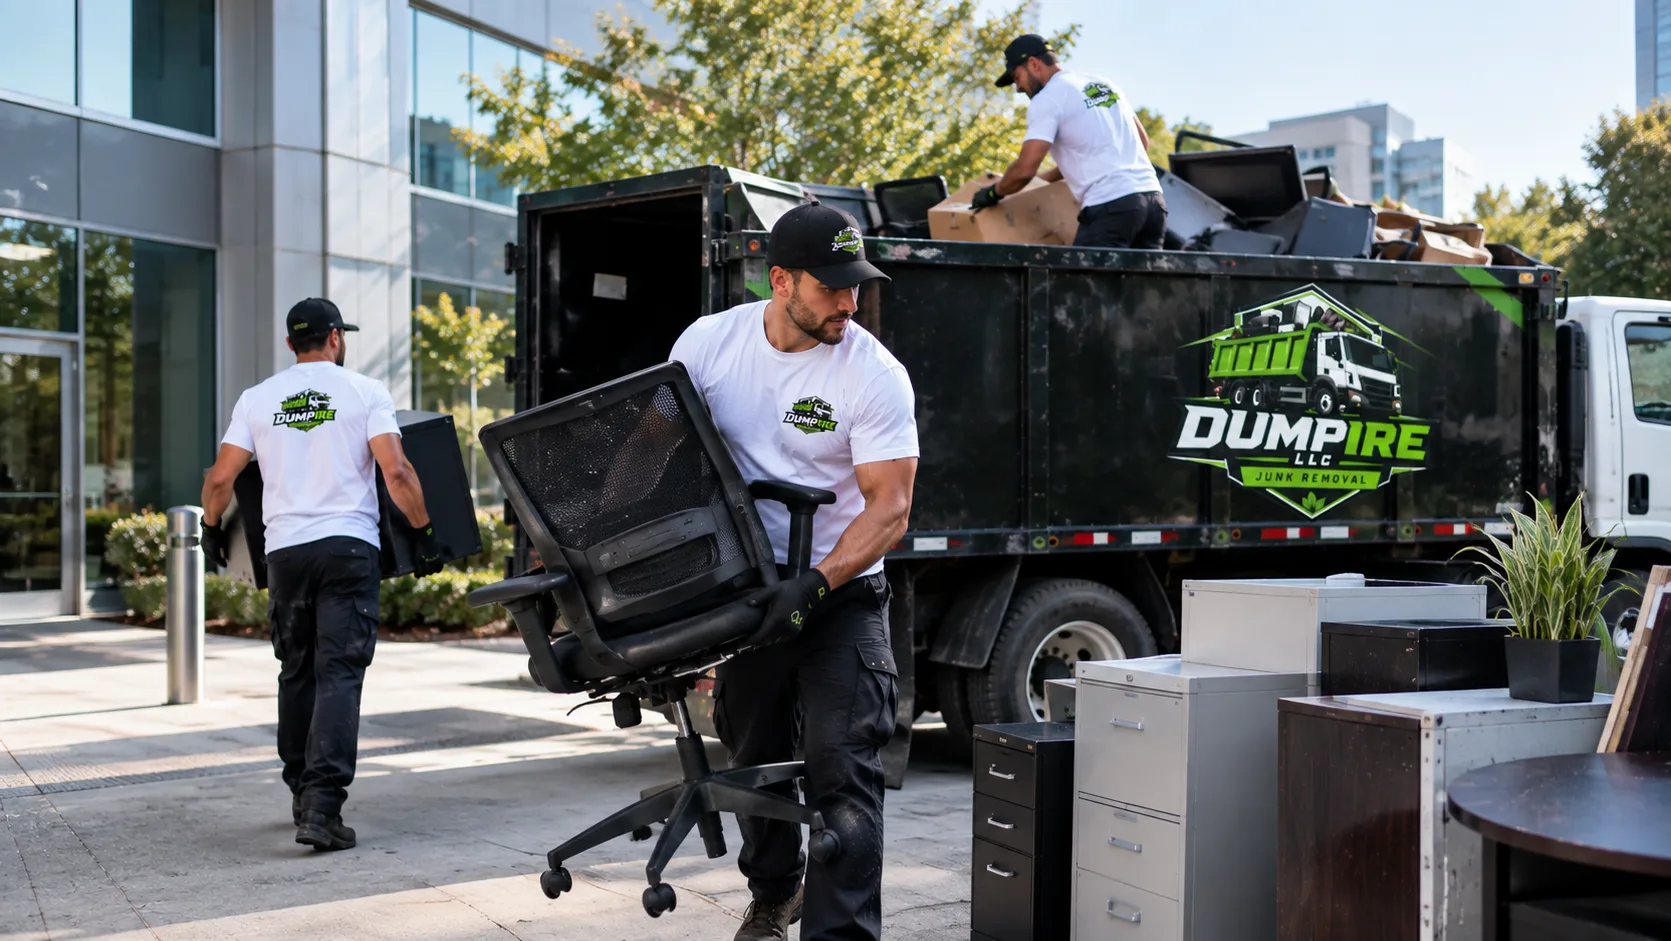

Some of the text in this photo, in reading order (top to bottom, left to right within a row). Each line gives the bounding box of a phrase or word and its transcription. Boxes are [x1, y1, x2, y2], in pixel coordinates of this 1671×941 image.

[274, 410, 335, 425] DUMPIRE
[1176, 404, 1431, 460] DUMPIRE
[1294, 452, 1332, 466] LLC
[1255, 471, 1367, 485] JUNK REMOVAL
